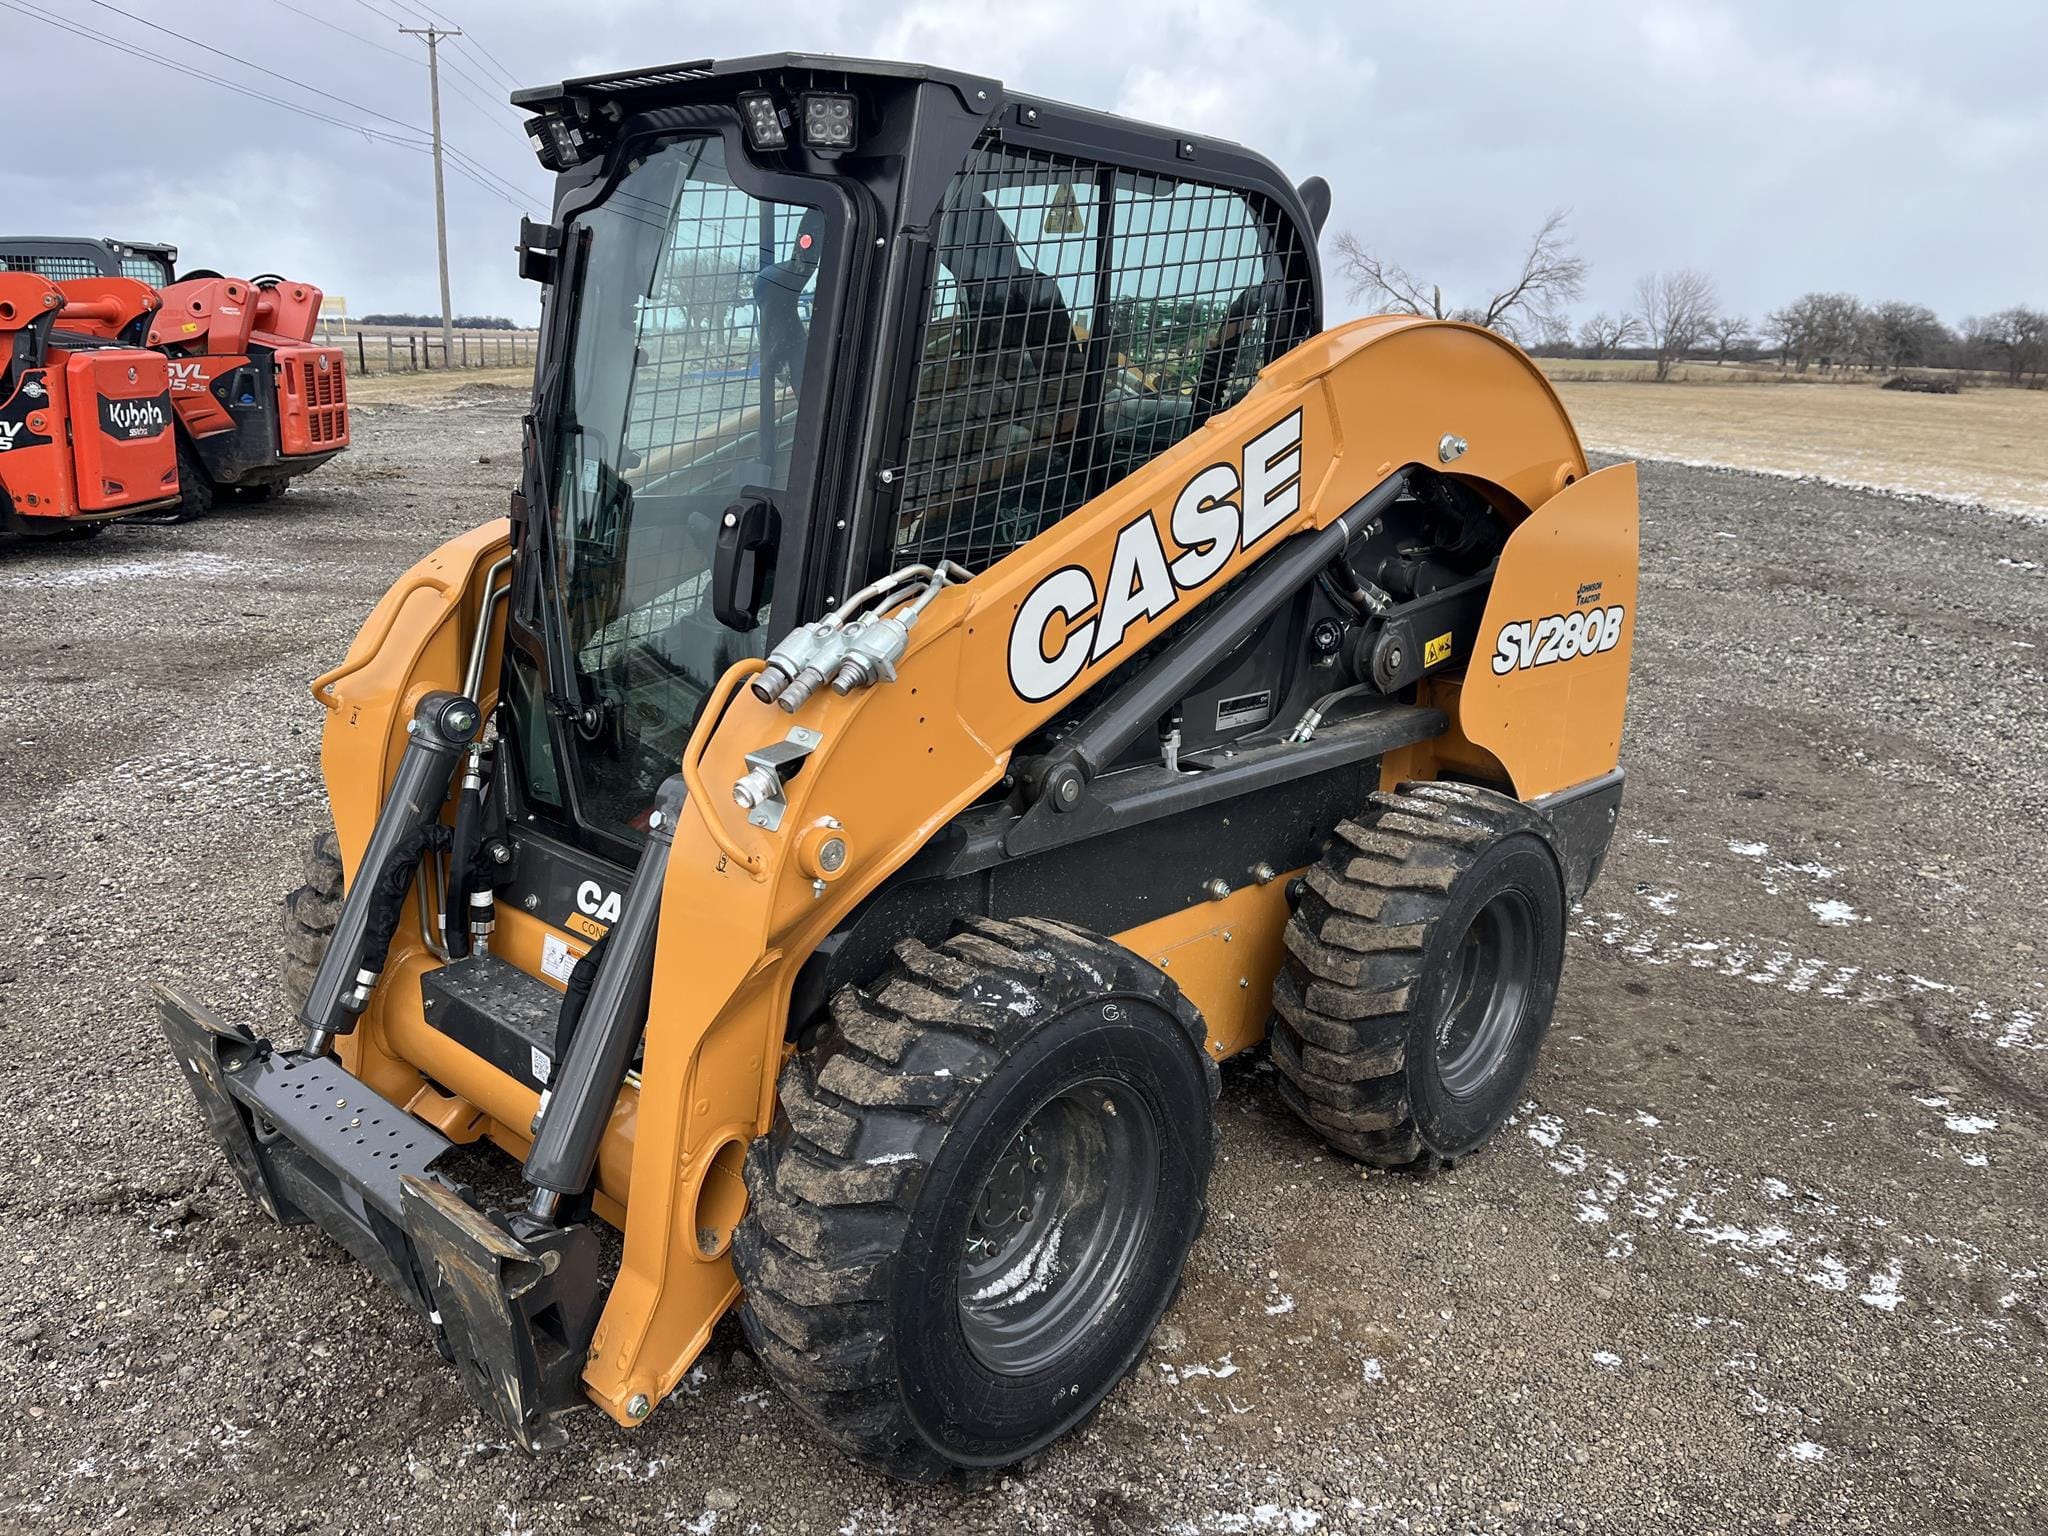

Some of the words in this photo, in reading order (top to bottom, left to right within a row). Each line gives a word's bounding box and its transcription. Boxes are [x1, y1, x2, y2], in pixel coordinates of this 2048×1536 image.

[0, 421, 24, 437] V
[109, 400, 163, 428] Kubota
[1007, 405, 1303, 703] CASE
[1491, 604, 1625, 676] SV280B
[577, 880, 622, 923] CA
